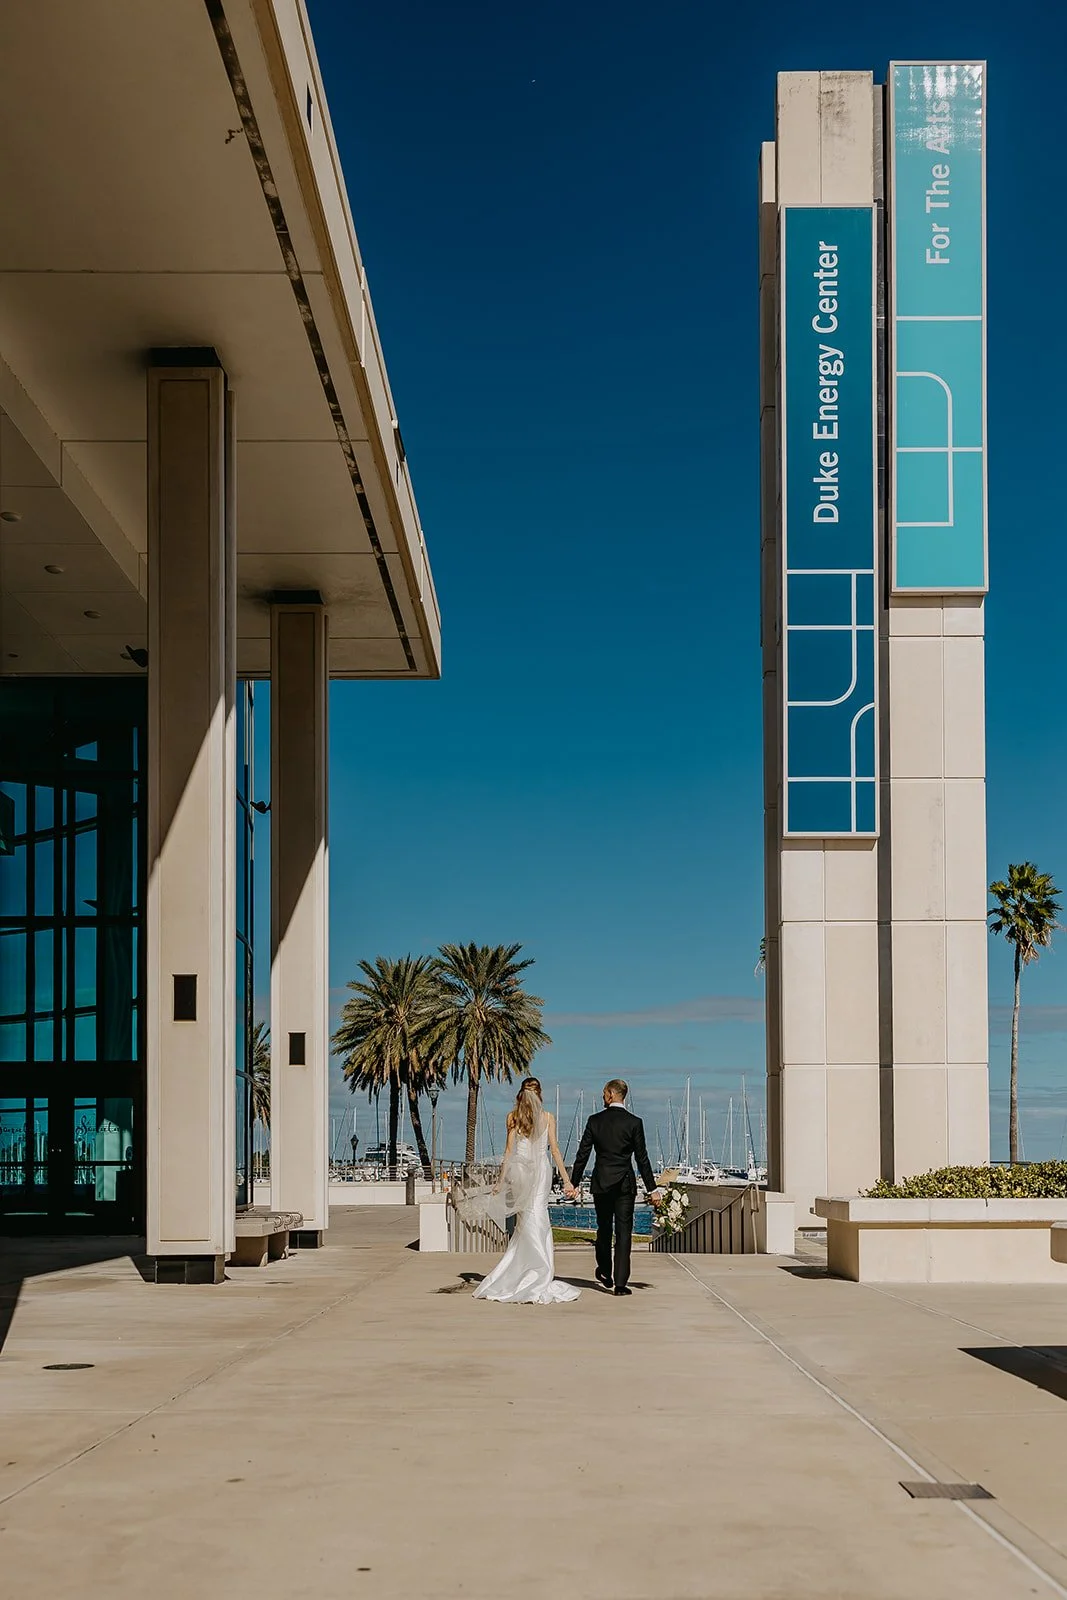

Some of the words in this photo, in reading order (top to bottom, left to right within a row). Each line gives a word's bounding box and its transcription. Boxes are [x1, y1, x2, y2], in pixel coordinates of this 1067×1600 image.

[926, 100, 950, 155] Arts
[925, 163, 950, 214] The
[925, 222, 950, 264] For
[811, 240, 838, 334] Center
[812, 344, 844, 440] Energy
[813, 451, 839, 523] Duke
